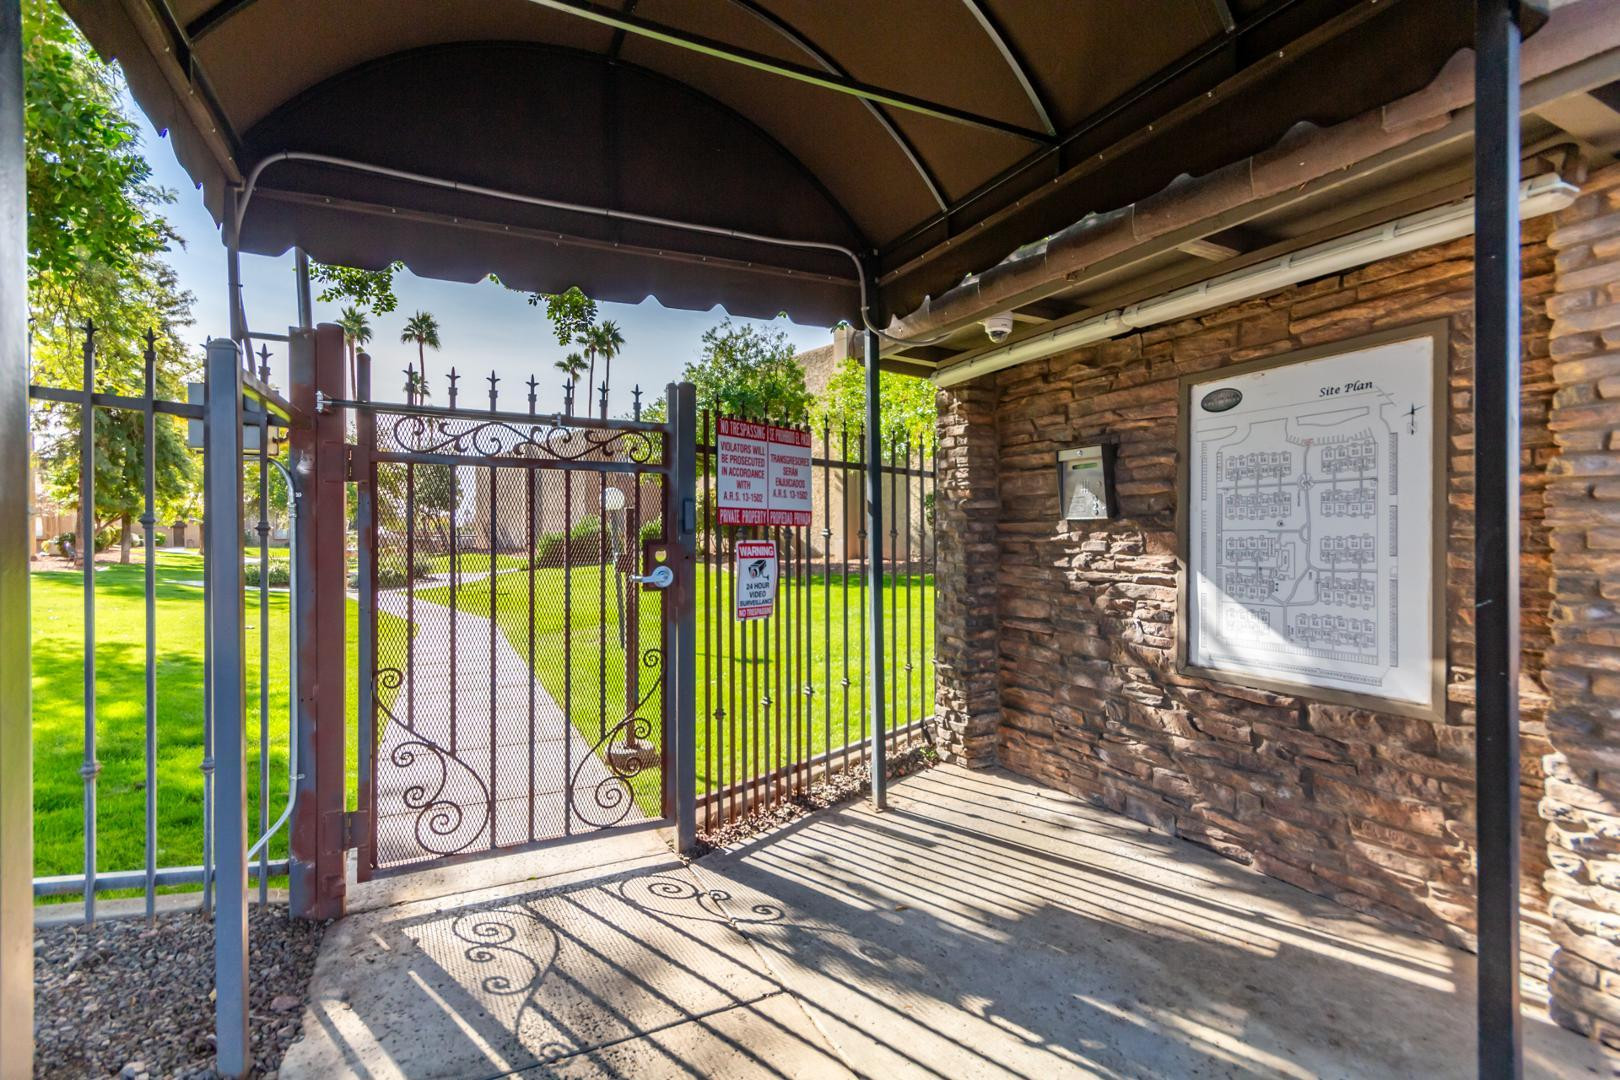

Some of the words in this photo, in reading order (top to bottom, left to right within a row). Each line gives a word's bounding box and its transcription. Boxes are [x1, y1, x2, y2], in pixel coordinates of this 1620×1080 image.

[1319, 386, 1341, 398] Site
[1344, 379, 1373, 393] Plan
[720, 419, 729, 434] NO
[730, 421, 766, 440] TRESPASSING
[720, 442, 752, 454] VIOLATORS
[752, 445, 765, 456] WILL
[721, 453, 729, 464] BE
[729, 455, 765, 468] PROSECUTED
[721, 466, 728, 476] IN
[728, 467, 765, 479] ACCORDANCE
[736, 480, 751, 490] WITH
[720, 508, 740, 524] PRIVATE
[739, 546, 774, 557] WARNING
[753, 581, 770, 589] HOUR
[749, 590, 766, 598] VIDEO
